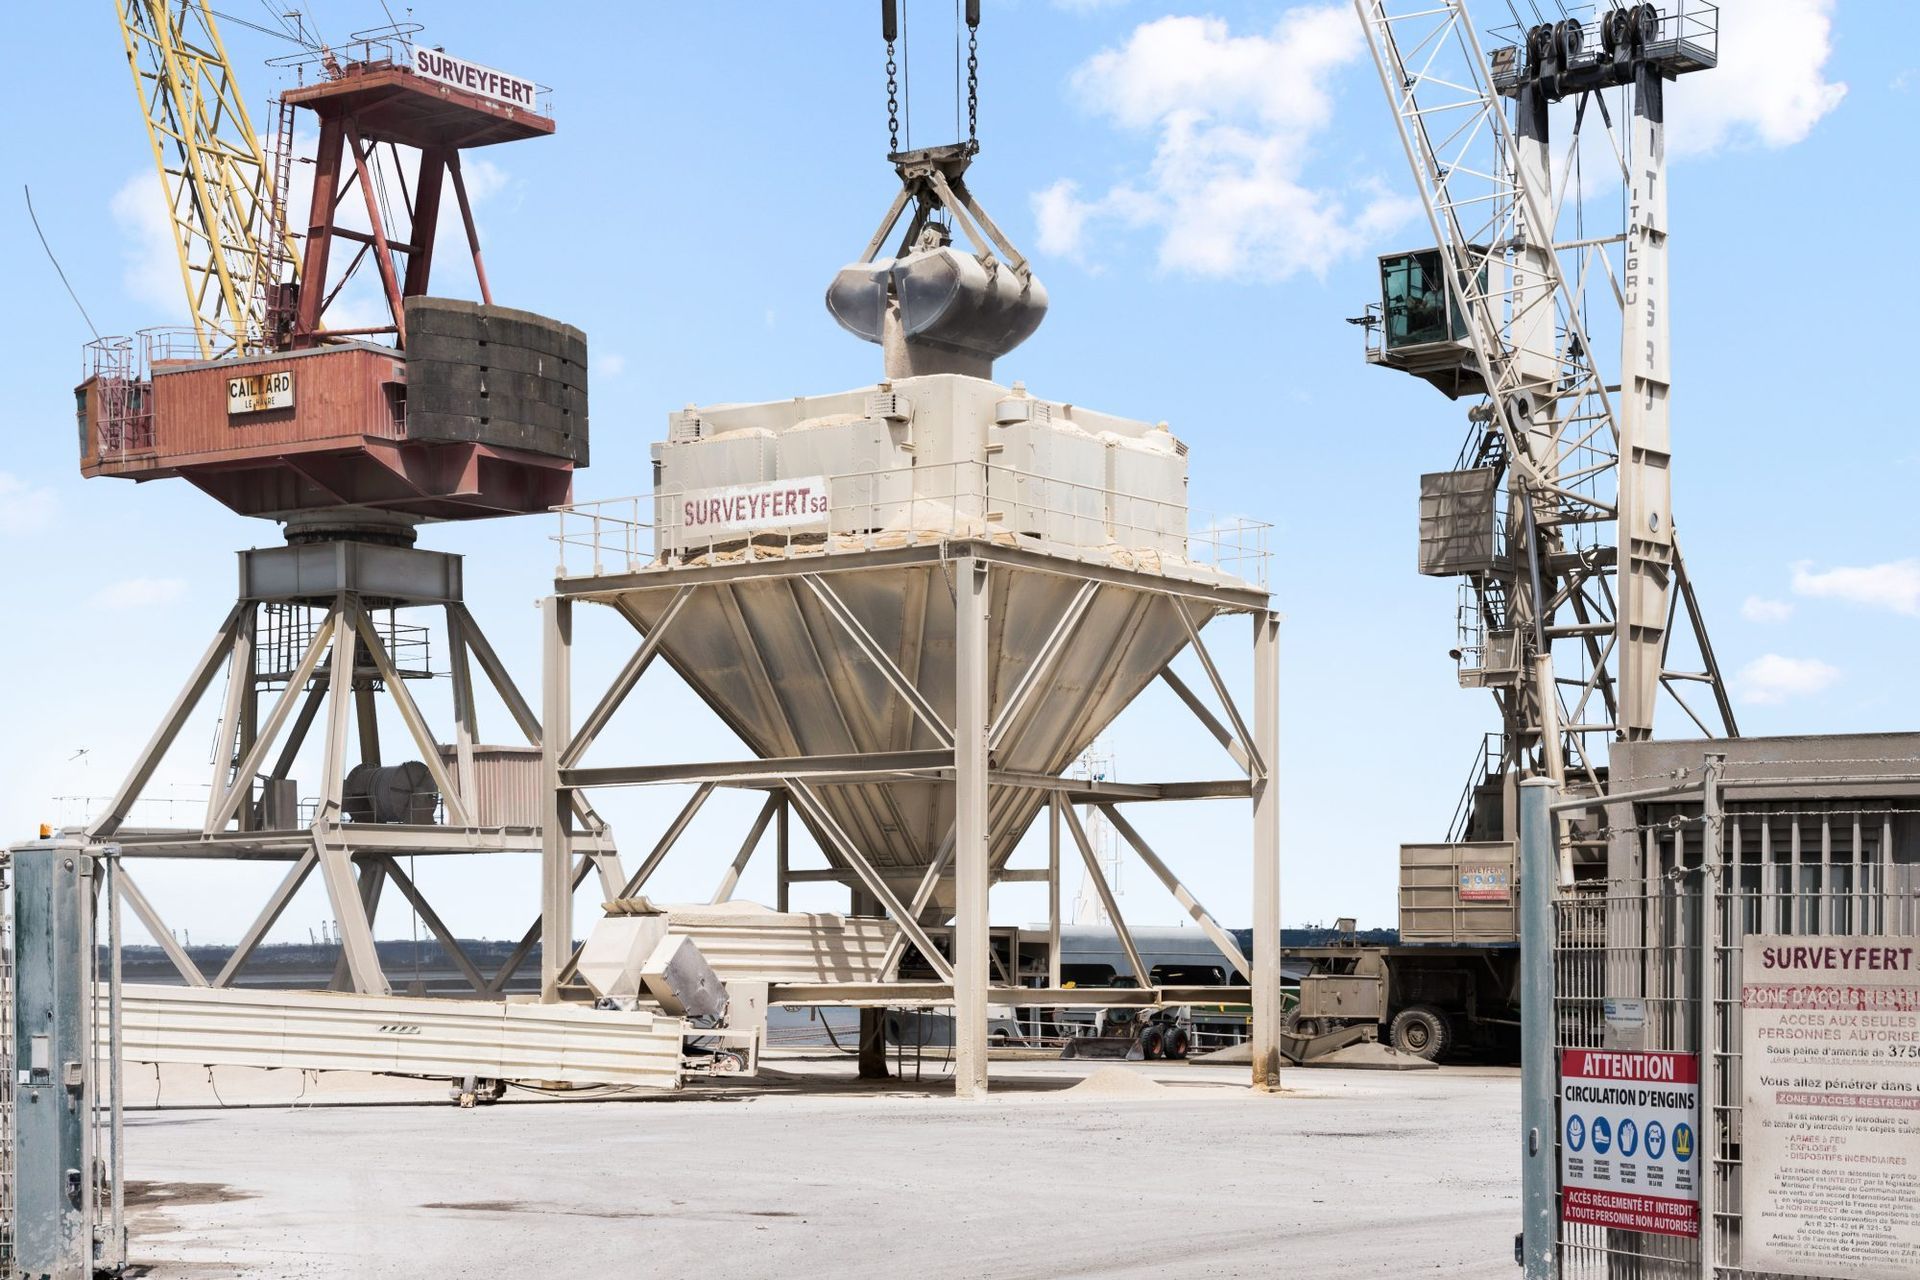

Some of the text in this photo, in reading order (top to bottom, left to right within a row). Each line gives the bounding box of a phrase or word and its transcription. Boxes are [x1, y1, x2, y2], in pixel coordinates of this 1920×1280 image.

[418, 51, 533, 104] SURVEYFERT
[1625, 188, 1640, 306] ITALGRU
[245, 400, 252, 408] LE
[1762, 947, 1913, 970] SURVEYFERT
[1779, 1014, 1917, 1028] ACCES AUX SEULES
[1758, 1028, 1841, 1041] PERSONNES
[1766, 1045, 1790, 1054] Sous
[1793, 1047, 1819, 1056] peine
[1822, 1047, 1869, 1057] d'amende
[1872, 1048, 1884, 1057] de
[1583, 1053, 1674, 1080] ATTENTION
[1760, 1075, 1790, 1087] Vous
[1793, 1077, 1821, 1088] allez
[1825, 1077, 1878, 1090] pénétrer
[1881, 1080, 1912, 1092] dans
[1565, 1086, 1694, 1110] CIRCULATION D'ENGINS
[1780, 1094, 1808, 1103] ZONE
[1860, 1096, 1918, 1107] RESTREINT
[1809, 1113, 1838, 1121] interdit
[1855, 1115, 1896, 1125] introduire
[1799, 1122, 1812, 1131] d'y
[1813, 1123, 1853, 1131] introduire
[1870, 1126, 1896, 1134] objets
[1790, 1135, 1819, 1143] ARMES
[1829, 1136, 1846, 1144] FEU
[1790, 1143, 1838, 1152] EXPLOSIFS
[1790, 1152, 1907, 1165] DISPOSITIFS INCENDIAIRES
[1644, 1201, 1654, 1212] ET
[1655, 1203, 1693, 1217] INTERDIT
[1571, 1206, 1594, 1220] TOUTE
[1595, 1209, 1635, 1225] PERSONNE
[1635, 1214, 1653, 1226] NON
